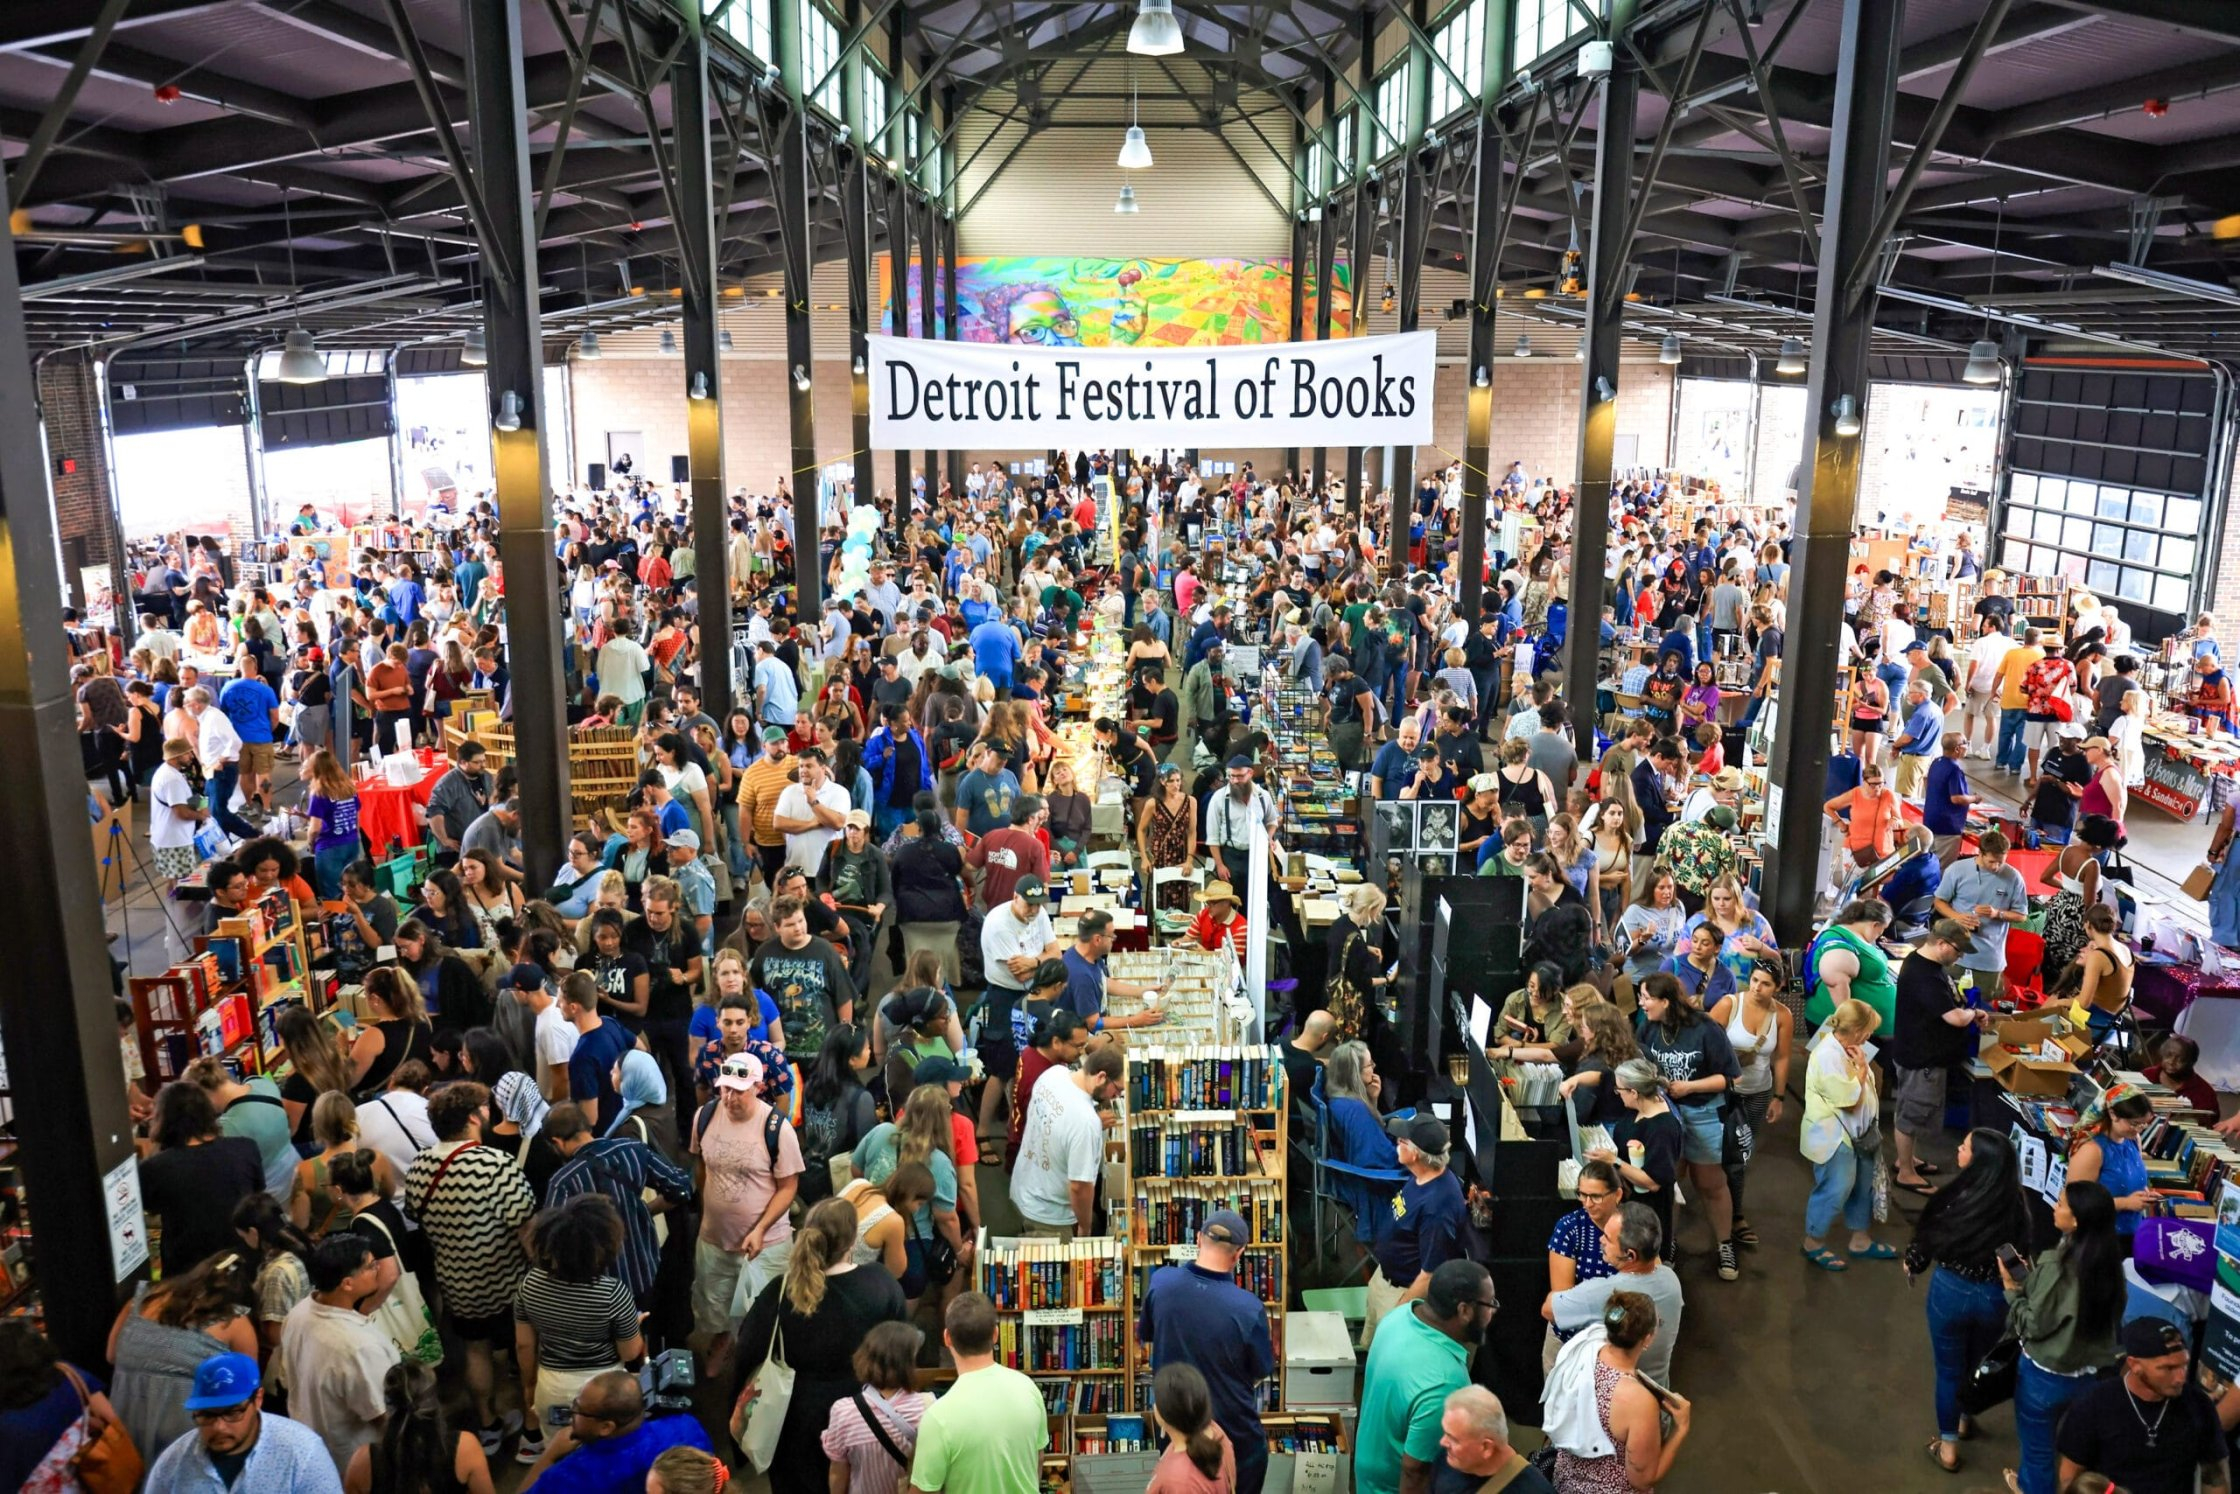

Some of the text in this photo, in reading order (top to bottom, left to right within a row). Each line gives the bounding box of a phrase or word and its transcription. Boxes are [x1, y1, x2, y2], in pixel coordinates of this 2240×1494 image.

[886, 354, 1415, 422] Detroit Festival of Books
